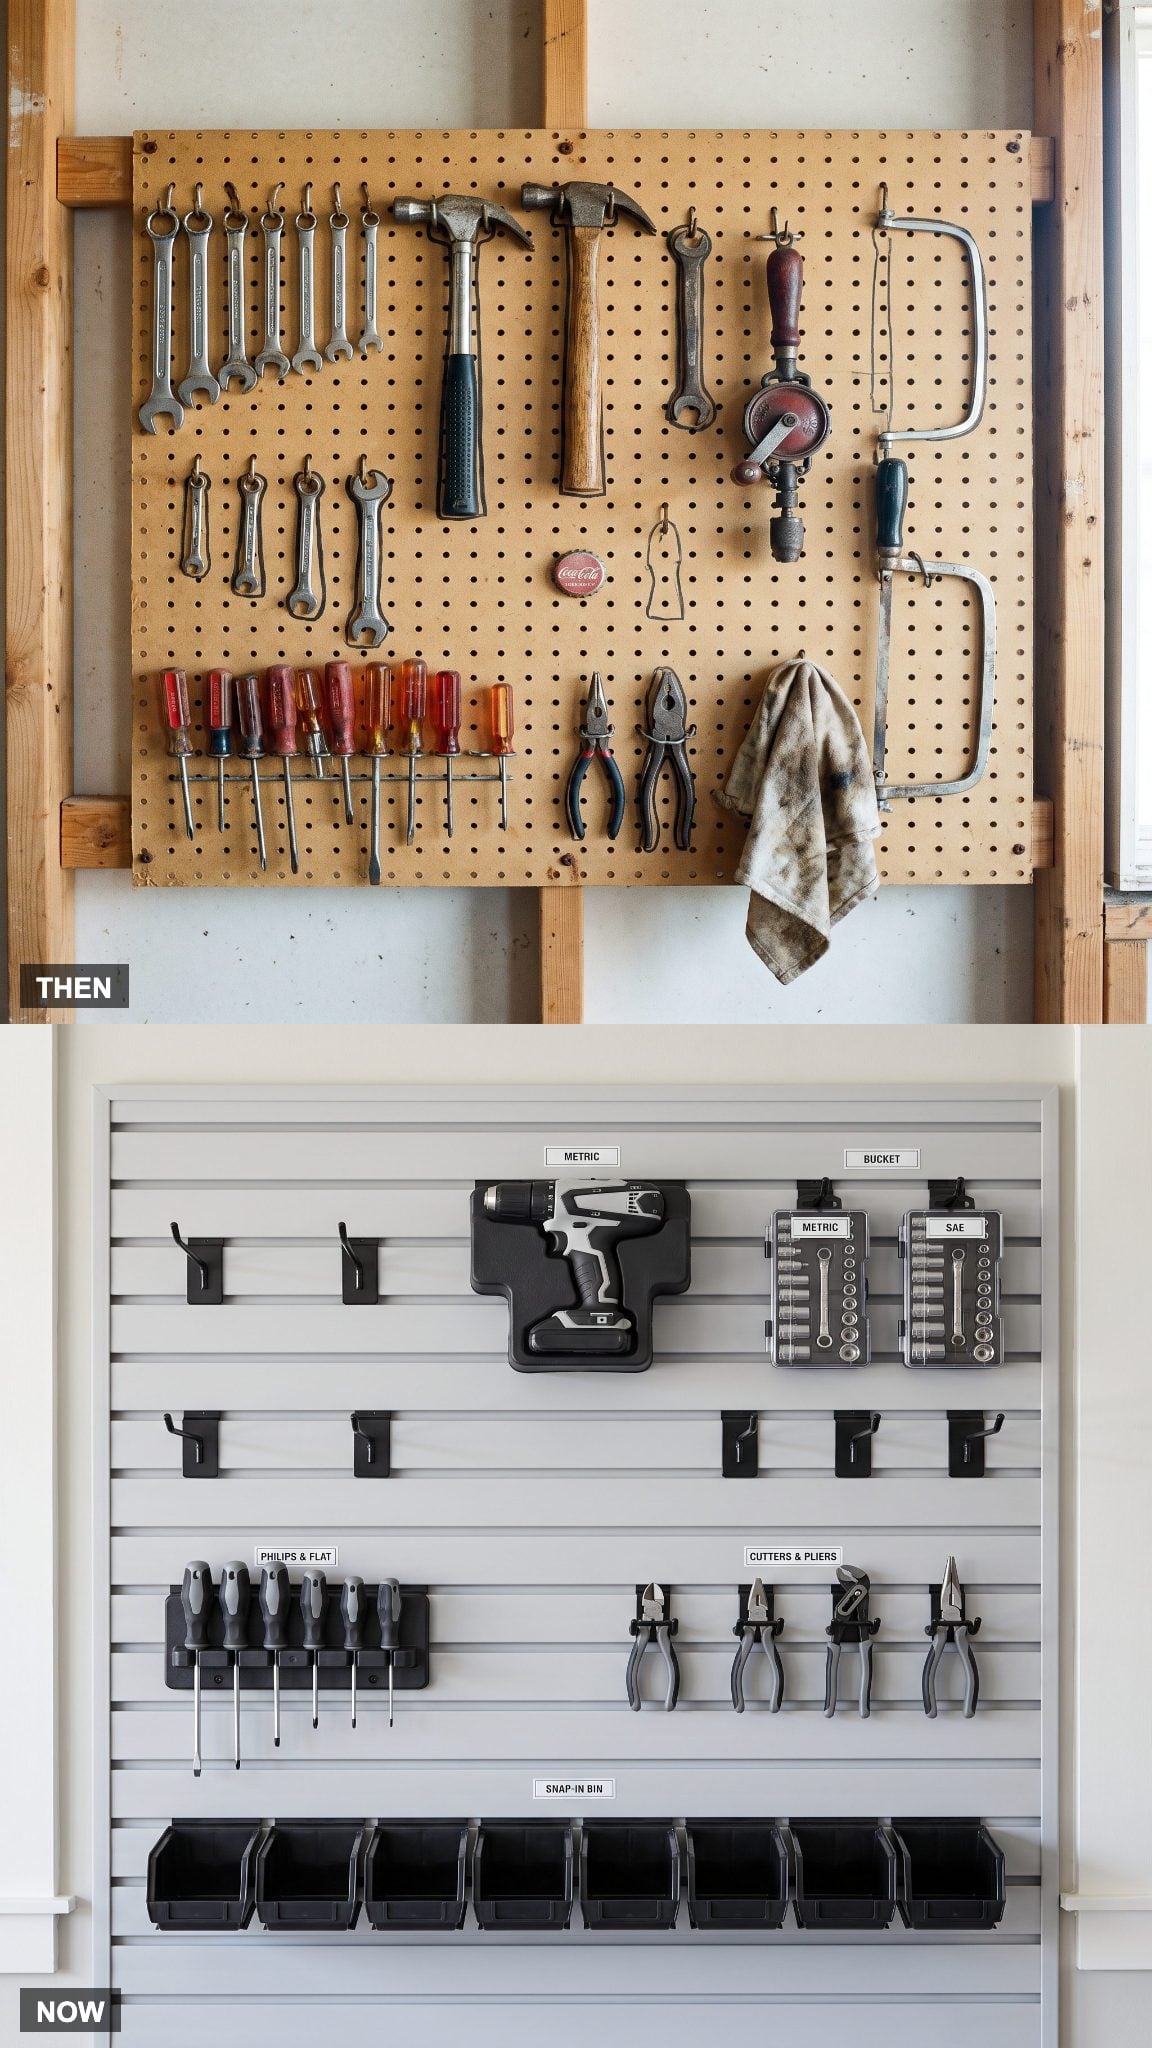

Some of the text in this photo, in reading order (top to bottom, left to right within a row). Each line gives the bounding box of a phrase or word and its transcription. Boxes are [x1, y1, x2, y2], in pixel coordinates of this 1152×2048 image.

[564, 1152, 600, 1161] METRIC
[863, 1154, 901, 1164] BUCKET
[802, 1223, 839, 1232] METRIC
[945, 1223, 965, 1232] SAE
[260, 1552, 332, 1561] PHILIPS & FLAT
[749, 1552, 837, 1561] CUTTERS & PLIERS
[545, 1784, 603, 1793] SNAP-IN BIN
